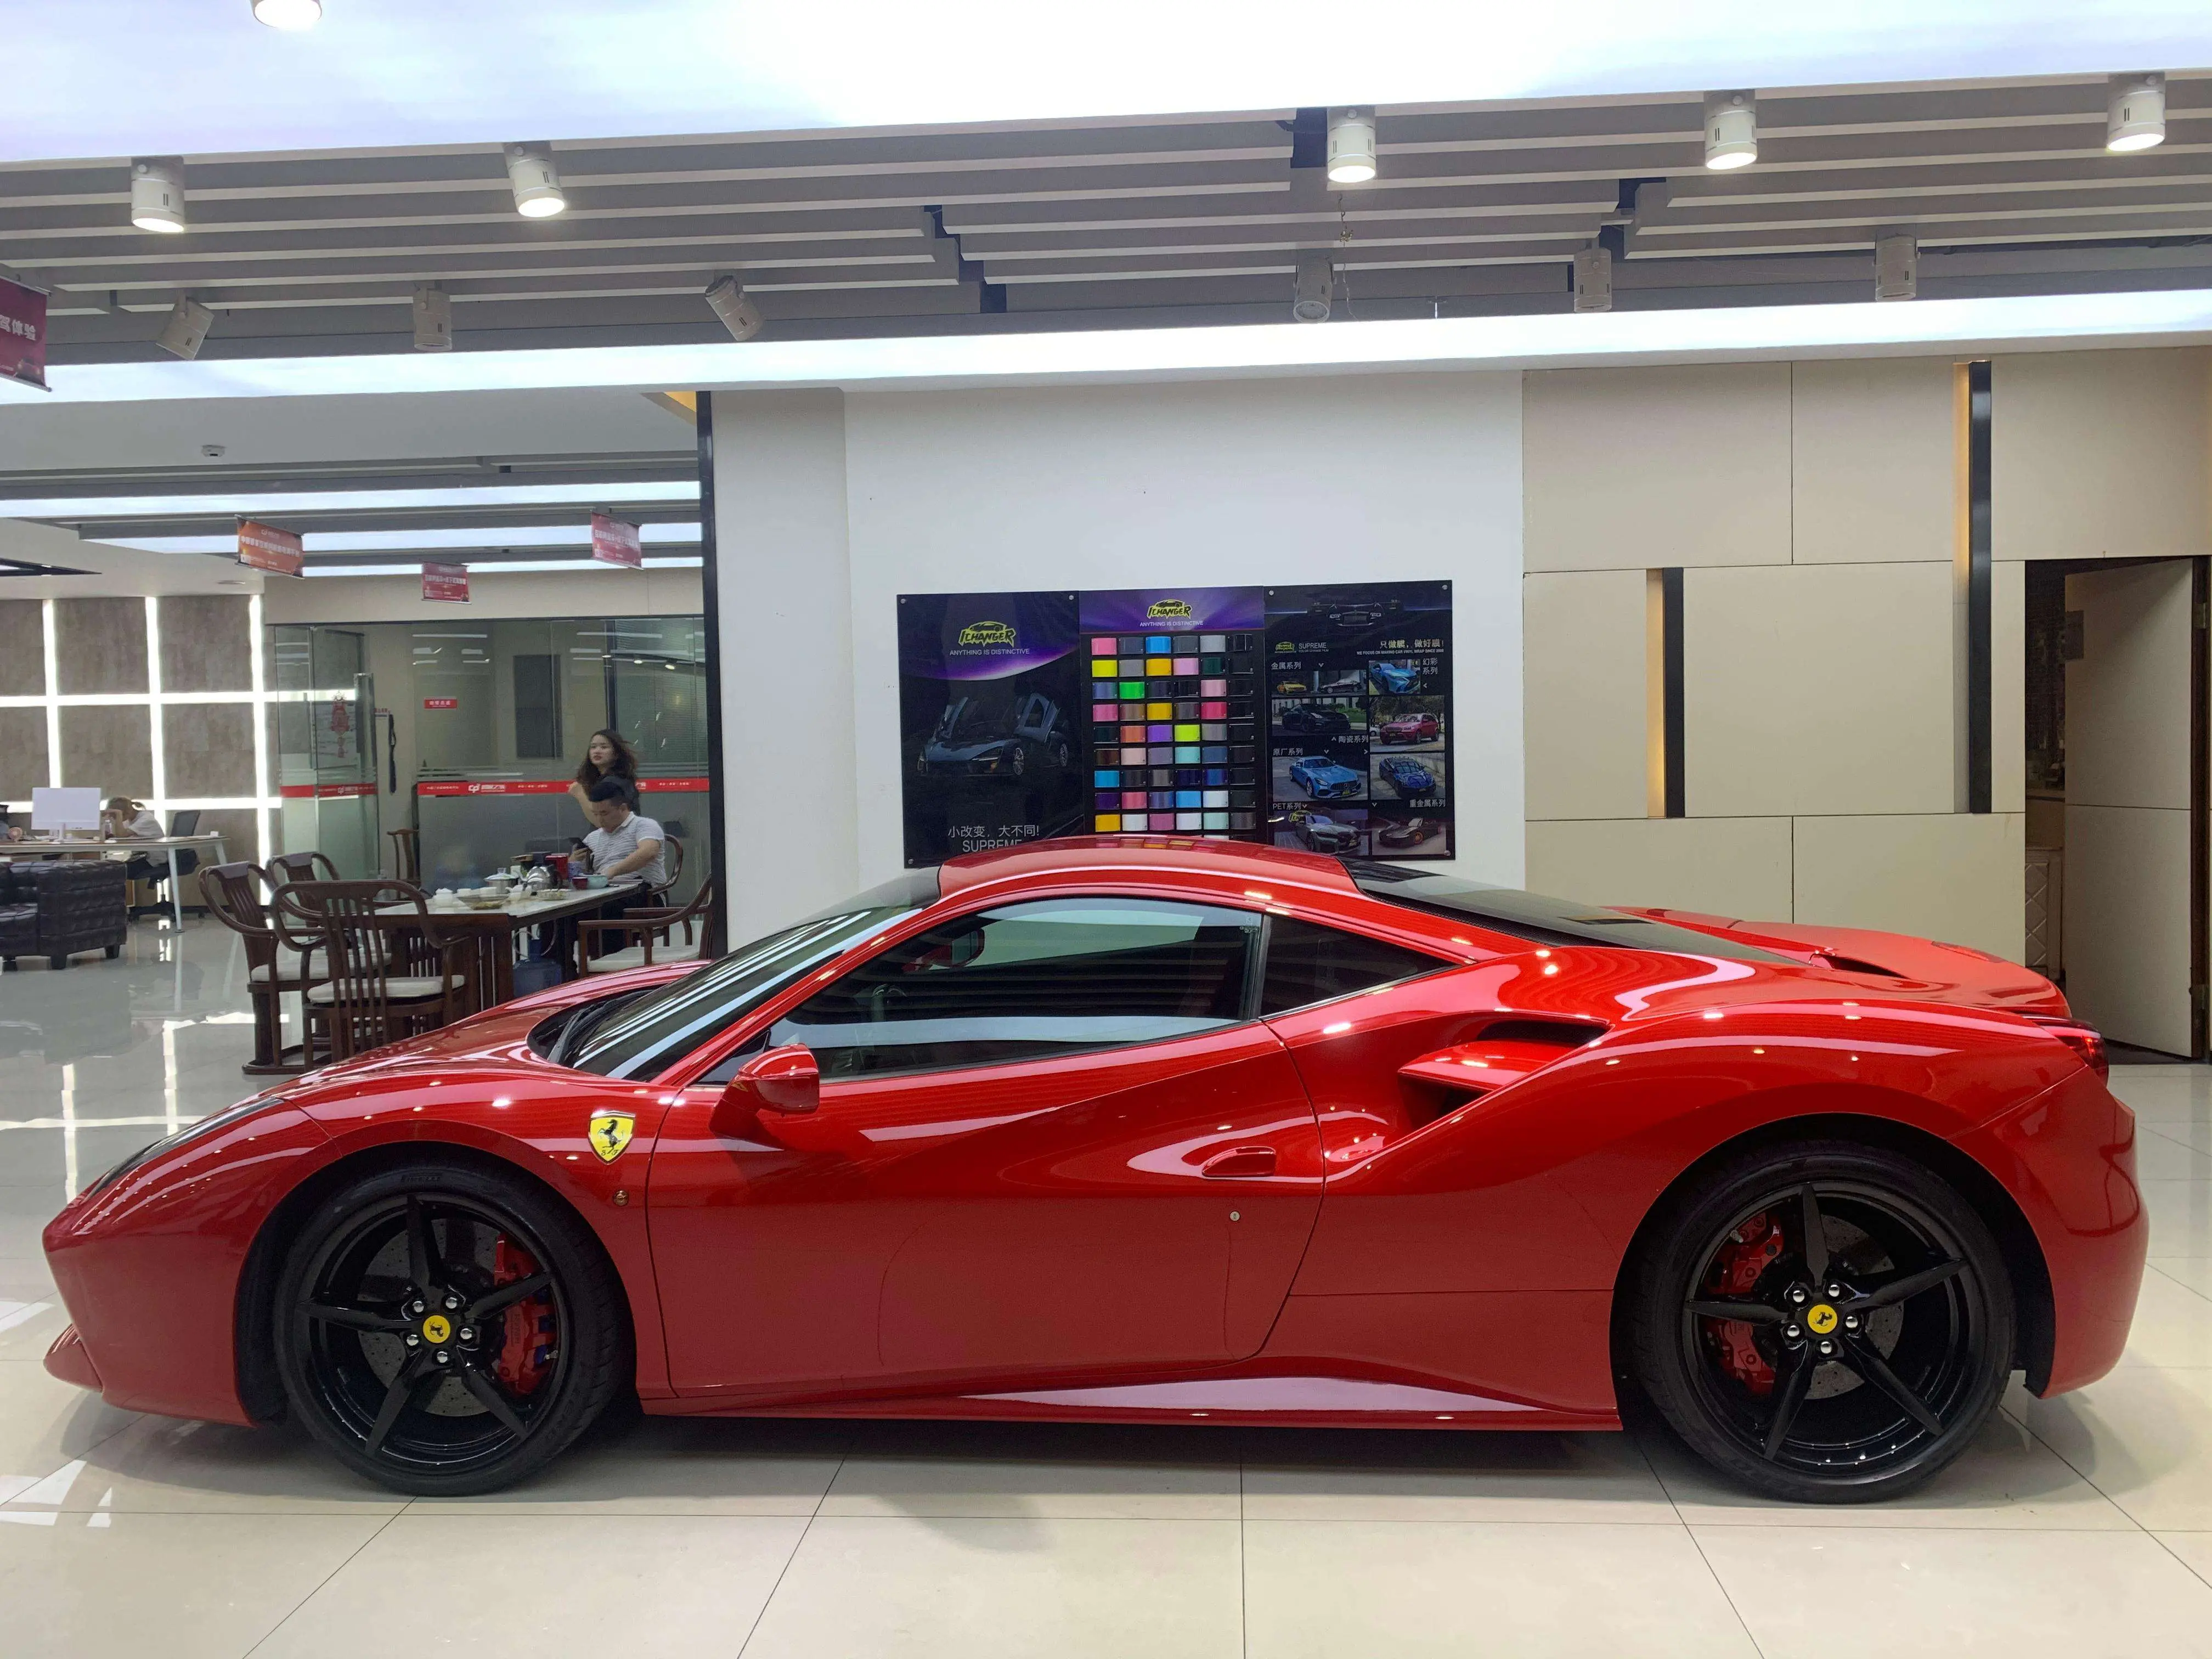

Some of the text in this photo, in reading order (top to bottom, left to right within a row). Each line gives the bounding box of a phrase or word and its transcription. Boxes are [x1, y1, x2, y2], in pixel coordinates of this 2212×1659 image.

[1423, 657, 1438, 665] 幻彩
[1271, 662, 1301, 670] 金属系列
[1423, 667, 1438, 675] 系列
[1338, 735, 1369, 743] 陶瓷系列
[1409, 799, 1446, 808] 重金属系列
[948, 825, 1040, 838] 小改变，大不同!
